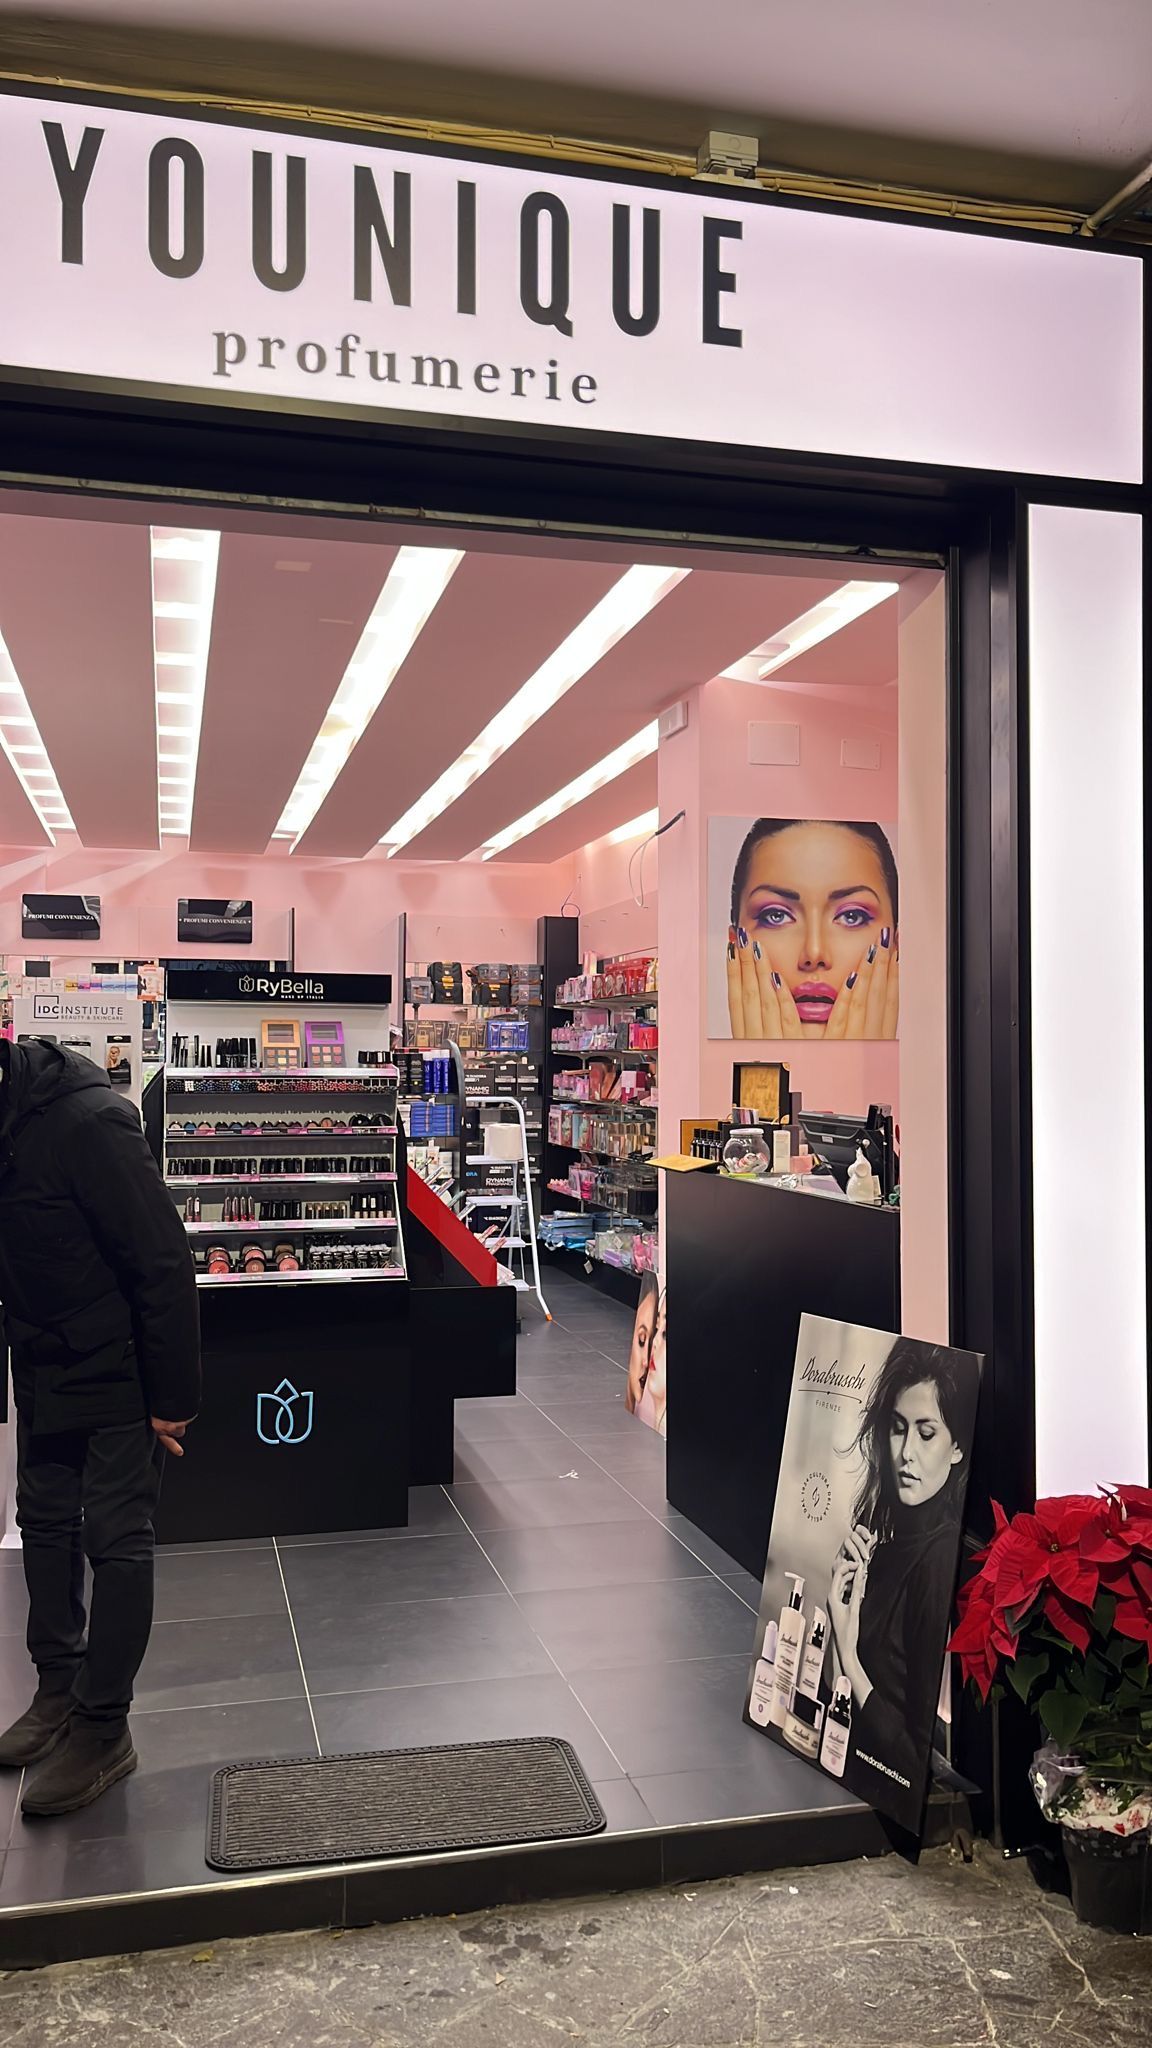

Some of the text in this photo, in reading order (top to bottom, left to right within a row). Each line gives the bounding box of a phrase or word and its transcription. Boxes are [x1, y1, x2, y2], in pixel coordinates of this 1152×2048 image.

[41, 120, 744, 349] YOUNIQUE
[212, 330, 600, 405] profumerie
[256, 979, 324, 997] RyBella
[800, 1356, 866, 1390] Dorabruschi
[815, 1400, 841, 1413] FIRENZE
[855, 1748, 911, 1789] www.dorabruschi.com
